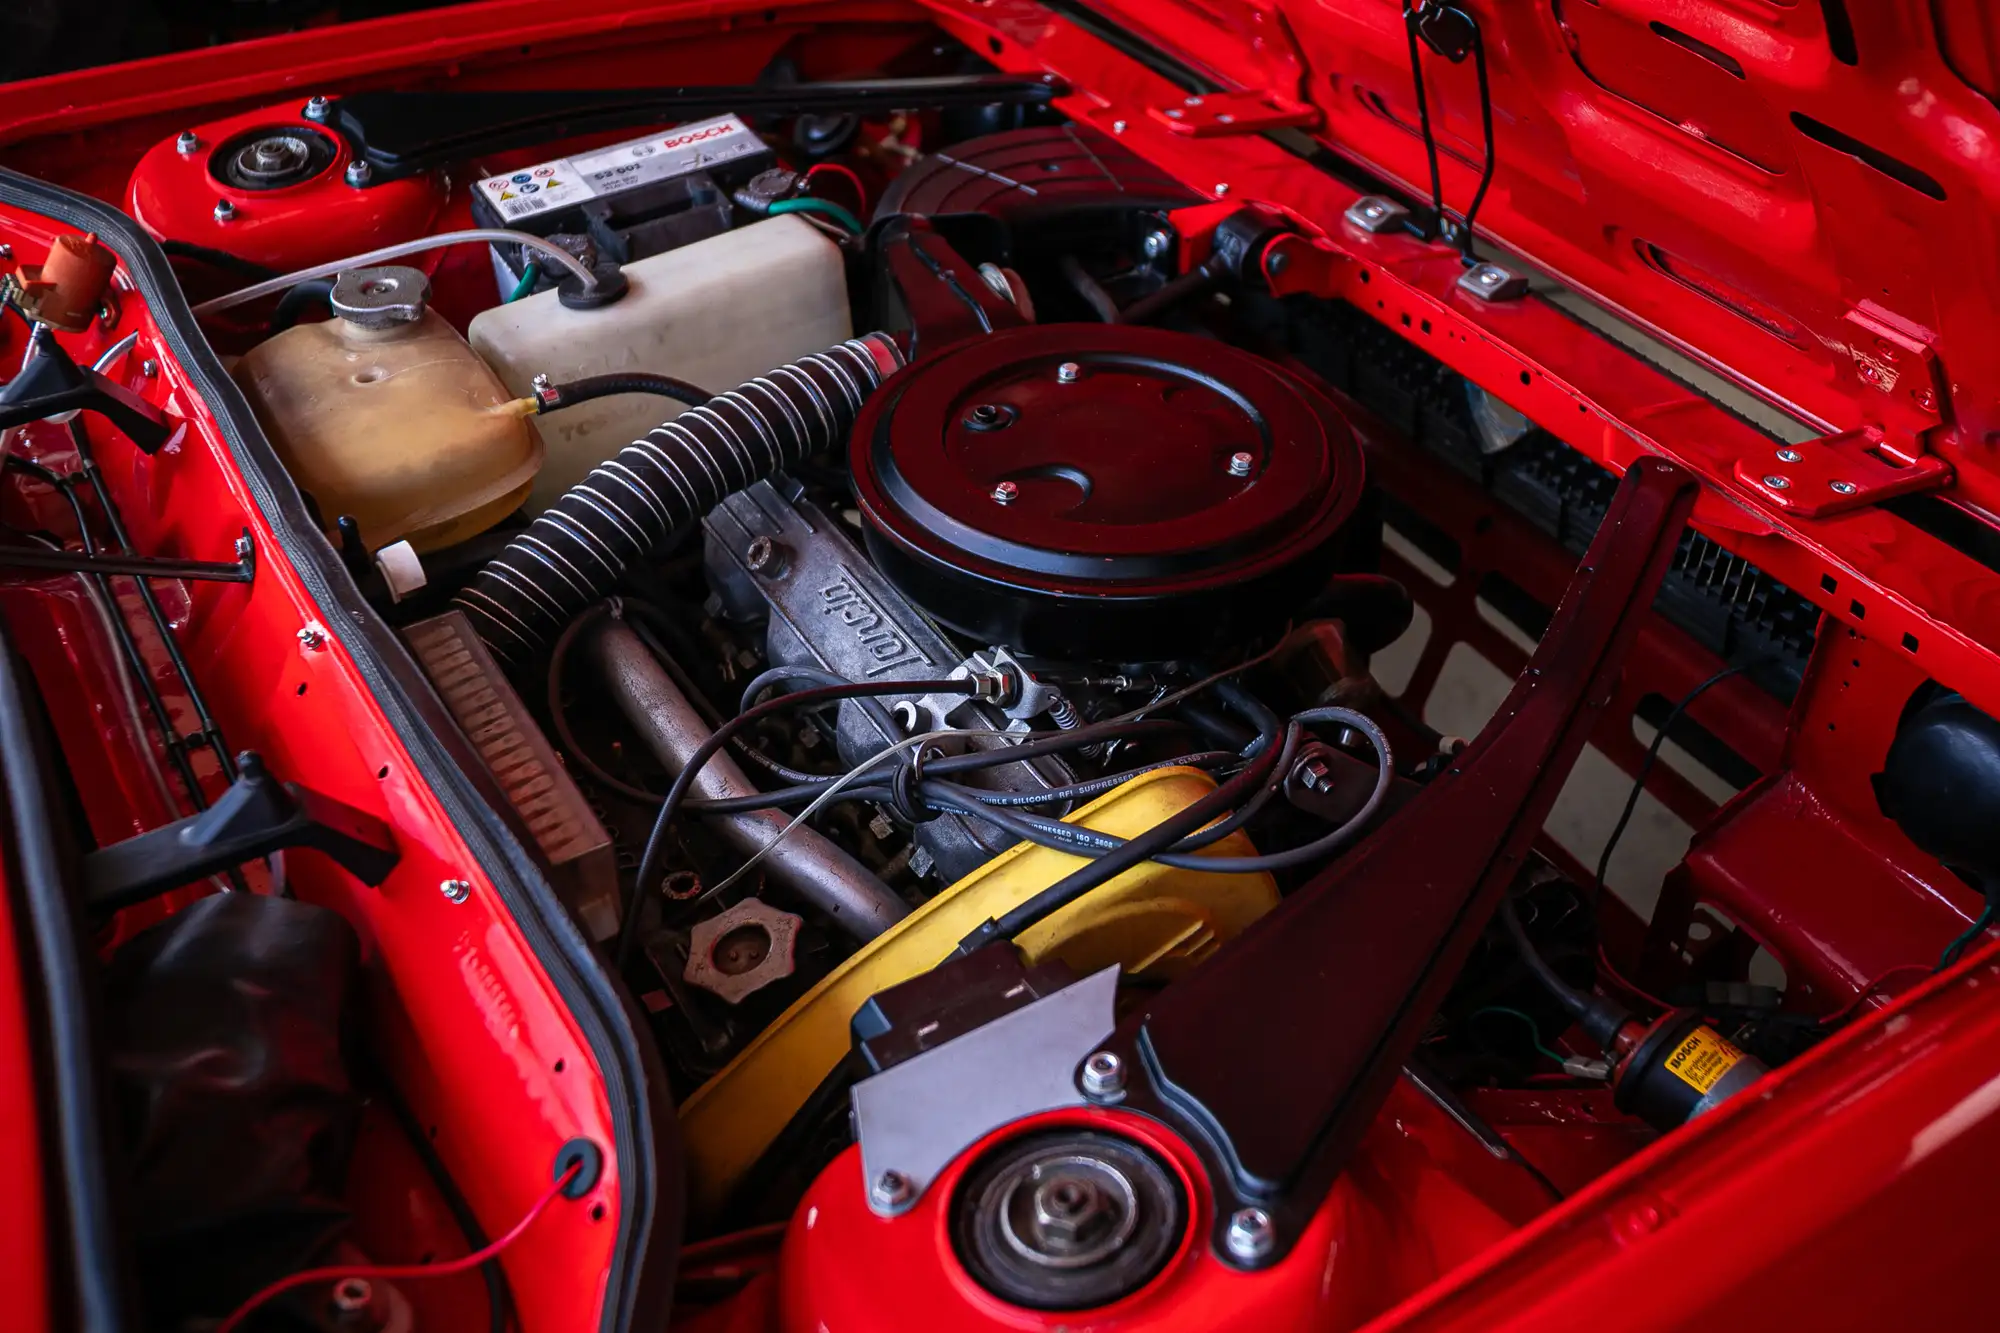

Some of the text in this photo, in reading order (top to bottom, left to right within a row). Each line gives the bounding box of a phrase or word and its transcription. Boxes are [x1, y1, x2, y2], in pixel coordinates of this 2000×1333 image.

[663, 124, 734, 149] BOSCH
[1012, 793, 1053, 805] SILICONE
[1059, 789, 1073, 799] RFI
[1078, 773, 1134, 794] SUPPRESSED
[1178, 755, 1201, 765] CLASS
[1076, 833, 1090, 843] ISO
[1670, 1036, 1703, 1069] BOSCH
